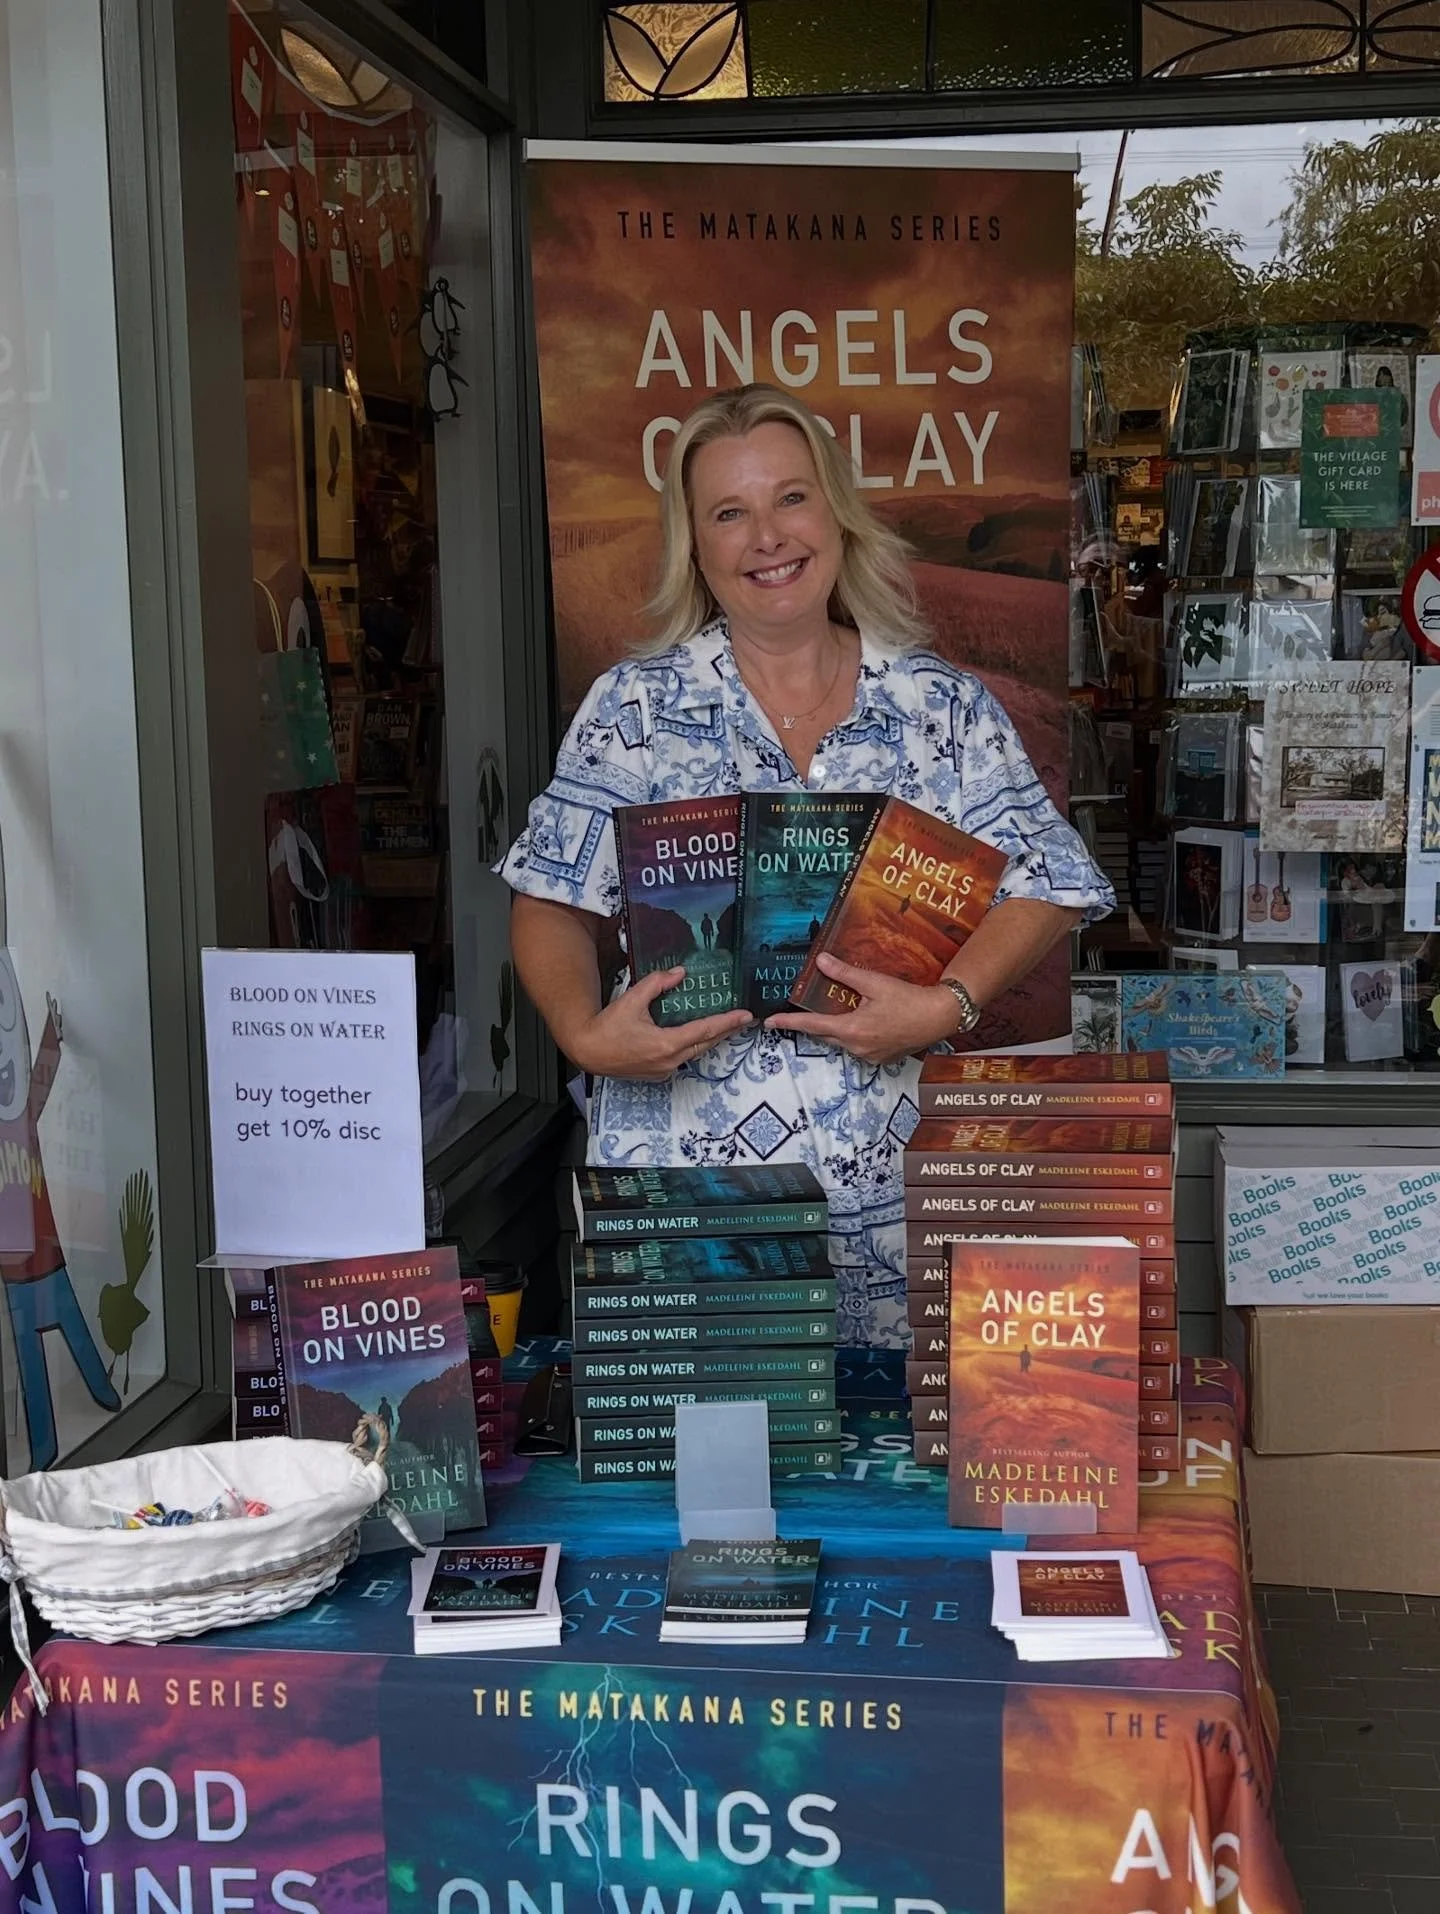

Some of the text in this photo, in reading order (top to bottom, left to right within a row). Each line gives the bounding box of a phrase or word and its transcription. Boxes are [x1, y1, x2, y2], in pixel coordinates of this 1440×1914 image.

[617, 211, 1001, 242] THE MATAKANA SERIES
[634, 308, 994, 389] ANGELS
[1313, 451, 1388, 462] THE VILLAGE
[1318, 466, 1382, 476] GIFT CARD
[1325, 480, 1369, 491] IS HERE
[1346, 679, 1397, 694] HOPE
[655, 831, 737, 860] BLOOD
[782, 827, 850, 848] RINGS
[641, 856, 738, 887] ON VINE
[757, 853, 789, 873] ON
[889, 842, 975, 897] ANGELS
[882, 864, 967, 918] OF CLAY
[230, 987, 376, 1005] BLOOD ON VINES
[232, 1021, 386, 1040] RINGS ON WATER
[235, 1082, 372, 1108] buy together
[934, 1094, 987, 1106] ANGELS
[990, 1094, 1008, 1106] OF
[1010, 1094, 1043, 1106] CLAY
[237, 1118, 381, 1141] get 10% disc
[920, 1163, 976, 1176] ANGELS
[979, 1163, 997, 1176] OF
[1000, 1163, 1035, 1177] CLAY
[1038, 1166, 1091, 1176] MADELEINE
[1243, 1175, 1296, 1204] Books
[1313, 1184, 1367, 1213] Books
[922, 1198, 977, 1212] ANGELS
[980, 1198, 998, 1212] OF
[1001, 1199, 1036, 1212] CLAY
[1040, 1202, 1091, 1211] MADELEINE
[1228, 1199, 1281, 1228] Books
[1383, 1191, 1438, 1220] Books
[596, 1219, 634, 1232] RINGS
[637, 1218, 655, 1230] ON
[657, 1216, 699, 1229] WATER
[1298, 1208, 1352, 1237] Books
[1368, 1216, 1423, 1245] Books
[1228, 1224, 1266, 1247] ooks
[1283, 1232, 1336, 1260] Books
[1353, 1240, 1407, 1269] Books
[303, 1266, 432, 1289] THE MATAKANA SERIES
[1268, 1256, 1321, 1284] Books
[588, 1296, 628, 1309] RINGS
[631, 1295, 650, 1307] ON
[653, 1294, 697, 1306] WATER
[980, 1289, 1105, 1317] ANGELS
[320, 1296, 422, 1331] BLOOD
[267, 1285, 286, 1405] BLOOD ON VINES
[302, 1324, 446, 1365] ON VINES
[588, 1330, 628, 1343] RINGS
[632, 1328, 650, 1340] ON
[654, 1327, 697, 1340] WATER
[981, 1320, 1106, 1349] OF CLAY
[586, 1364, 626, 1377] RINGS
[629, 1363, 648, 1375] ON
[651, 1362, 695, 1375] WATER
[703, 1362, 754, 1372] MADELEINE
[252, 1405, 280, 1417] BLO
[587, 1396, 627, 1409] RINGS
[630, 1395, 649, 1407] ON
[651, 1394, 696, 1406] WATER
[594, 1427, 656, 1441] RINGS ON
[769, 1423, 808, 1432] SKEDAHL
[1053, 1449, 1090, 1458] AUTHOR
[390, 1464, 466, 1491] LEINE
[594, 1459, 656, 1474] RINGS ON
[964, 1461, 1119, 1485] MADELEINE
[975, 1486, 1110, 1509] ESKEDAHL
[459, 1556, 524, 1565] BLOOD
[692, 1555, 810, 1564] ON WATER
[718, 1547, 788, 1556] RINGS
[443, 1561, 536, 1571] ON VINES
[1035, 1567, 1104, 1575] ANGELS
[165, 1678, 288, 1709] SERIES
[473, 1688, 903, 1731] THE MATAKANA SERIES
[1104, 1711, 1169, 1740] THE
[536, 1783, 842, 1869] RINGS
